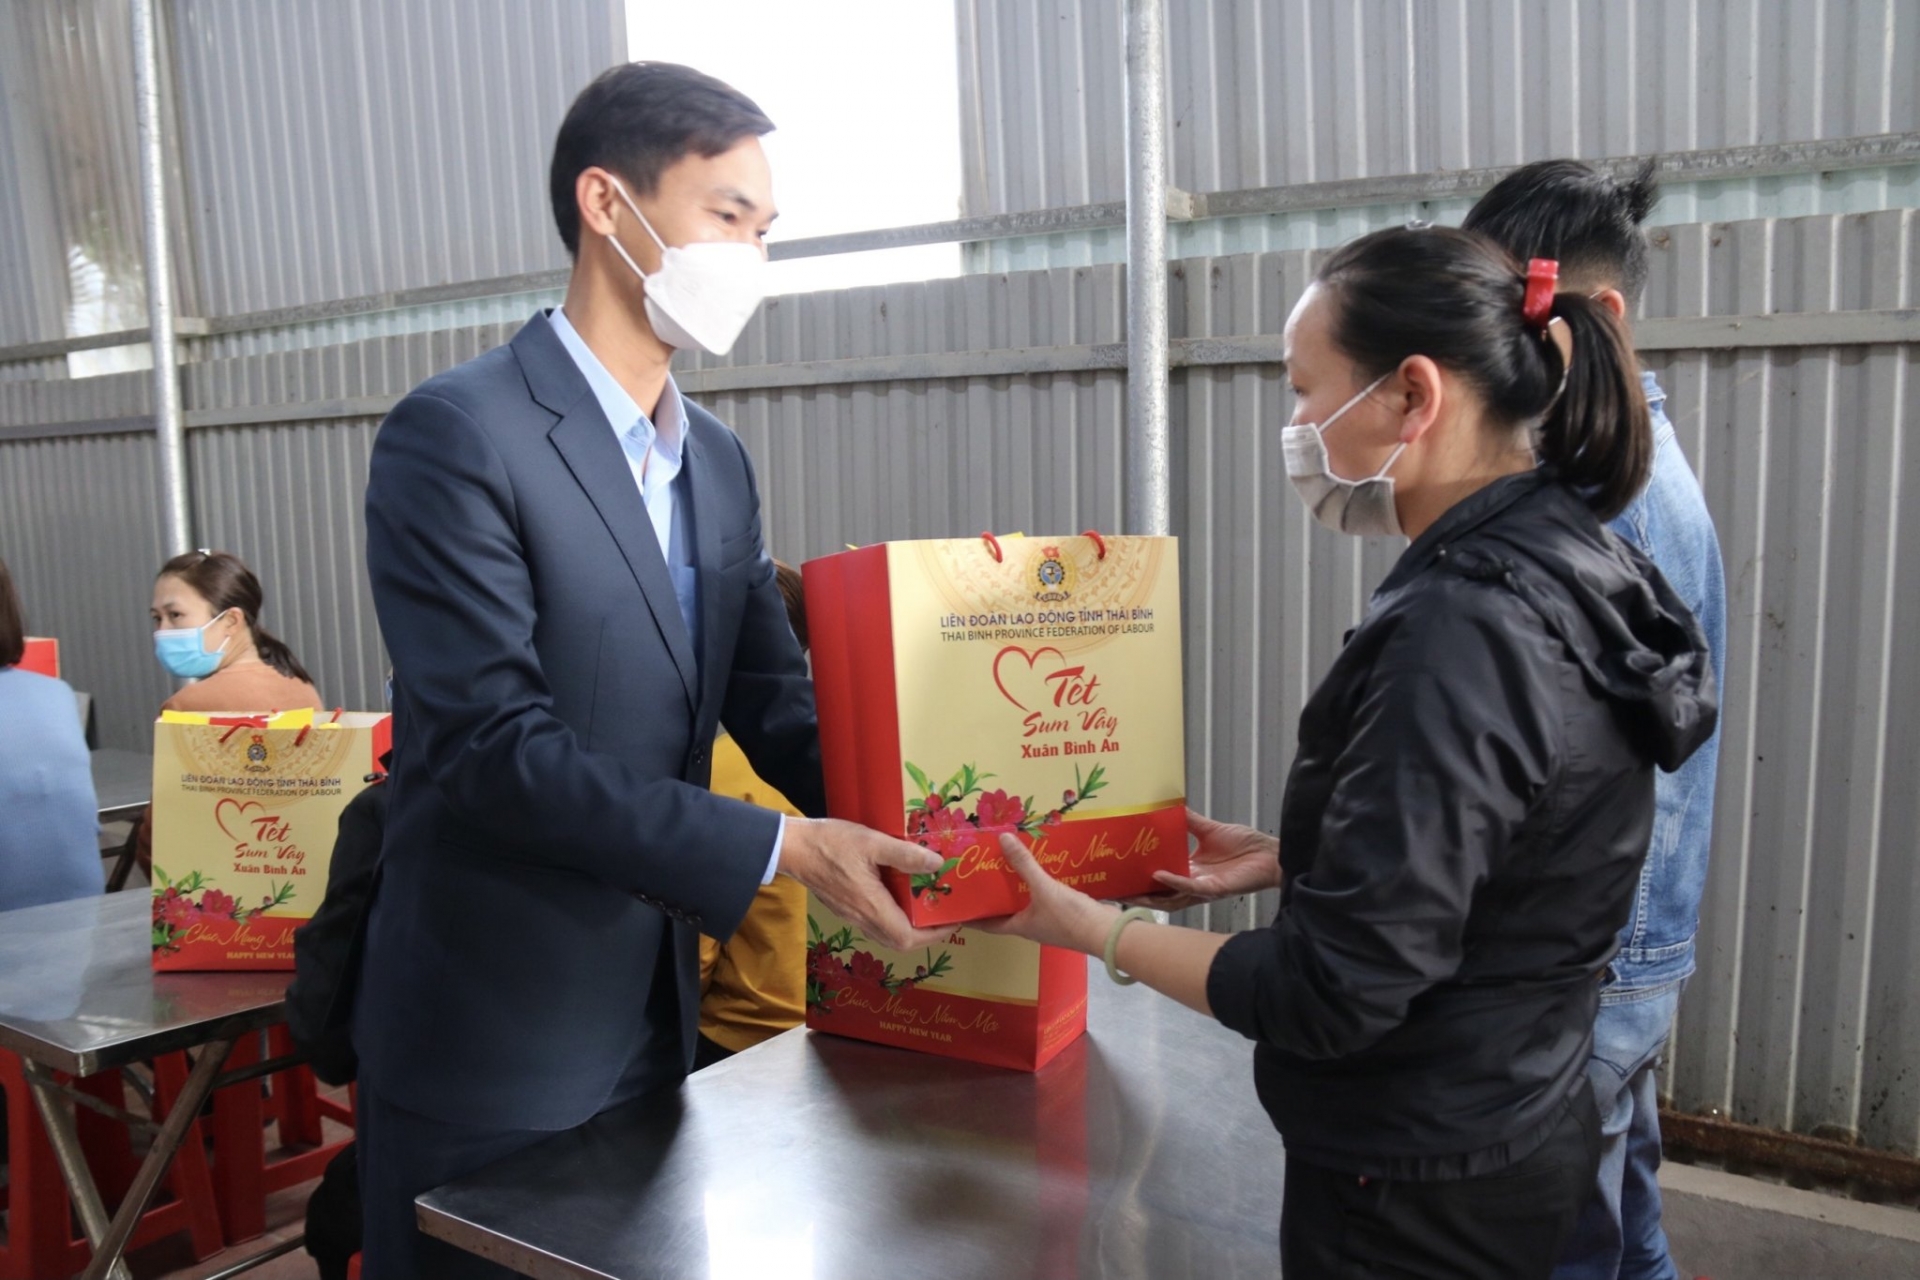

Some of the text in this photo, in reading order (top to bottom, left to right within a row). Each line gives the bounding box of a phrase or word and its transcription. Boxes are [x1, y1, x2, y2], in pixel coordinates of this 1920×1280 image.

[941, 613, 966, 628] LIÊN
[969, 611, 1007, 627] ĐOÀN
[1010, 612, 1035, 625] LAO
[1038, 609, 1076, 626] ĐỘNG
[1106, 606, 1129, 621] THÁI
[1132, 605, 1154, 620] BÌNH
[940, 623, 1155, 642] THAI BINH PROVINCE FEDERATION OF LABOUR
[1022, 711, 1070, 738] Sum
[1021, 738, 1120, 759] Xuân Bình An
[252, 788, 298, 796] FEDERATION
[299, 788, 309, 796] OF
[310, 788, 342, 796] LABOUR
[235, 842, 268, 859] Sum
[233, 862, 260, 874] Xuân
[291, 865, 306, 876] An
[1081, 871, 1107, 883] YEAR
[949, 933, 966, 946] An
[226, 951, 295, 960] HAPPY NEW YEA
[879, 1020, 953, 1043] HAPPY NEW YEAR
